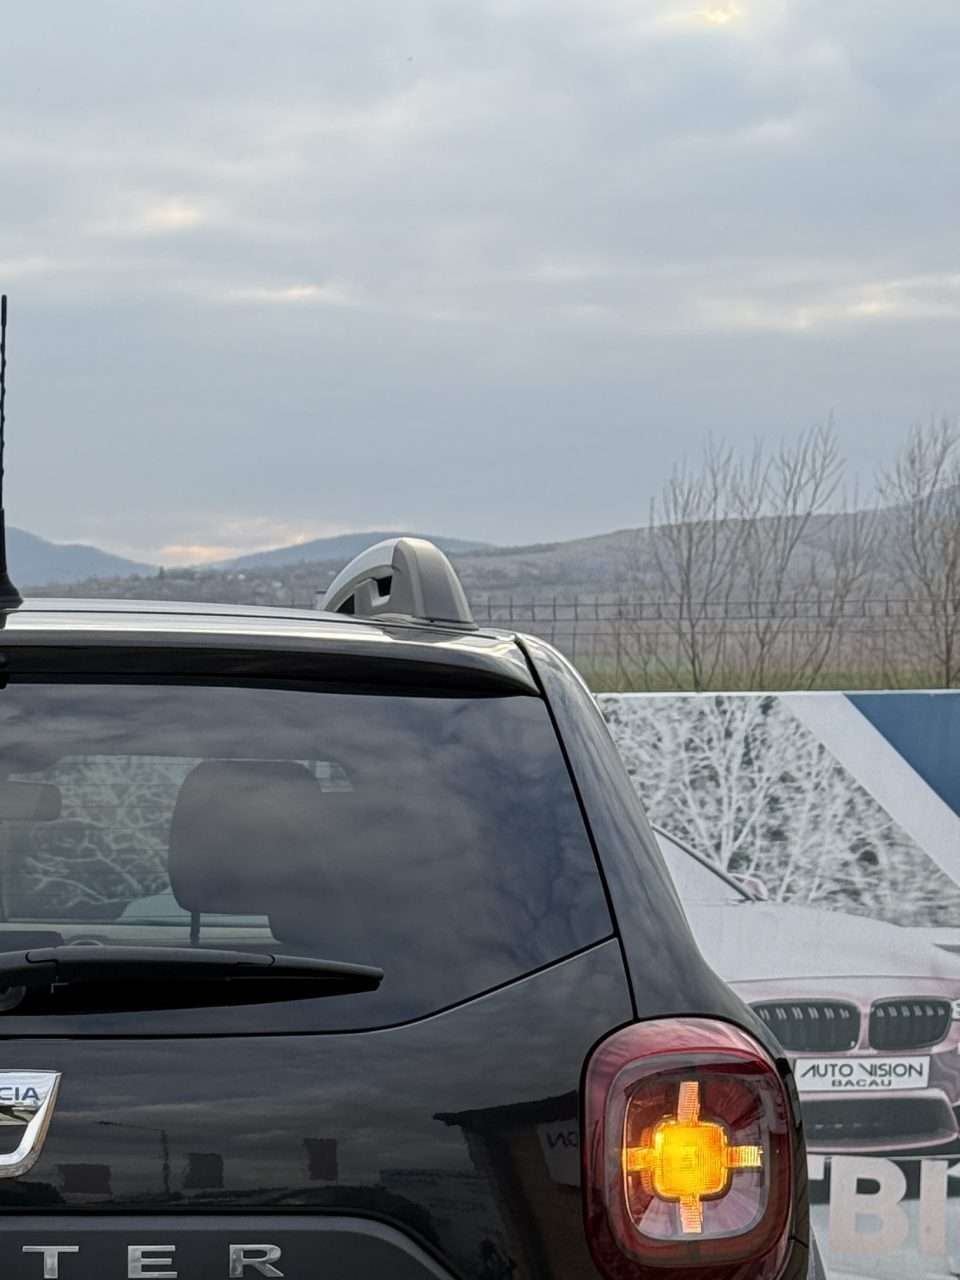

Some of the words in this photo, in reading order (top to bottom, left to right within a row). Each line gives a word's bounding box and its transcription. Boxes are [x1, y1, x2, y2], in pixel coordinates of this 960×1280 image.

[800, 1062, 854, 1078] AUTO
[858, 1062, 924, 1077] VISION
[831, 1078, 893, 1087] BACAU
